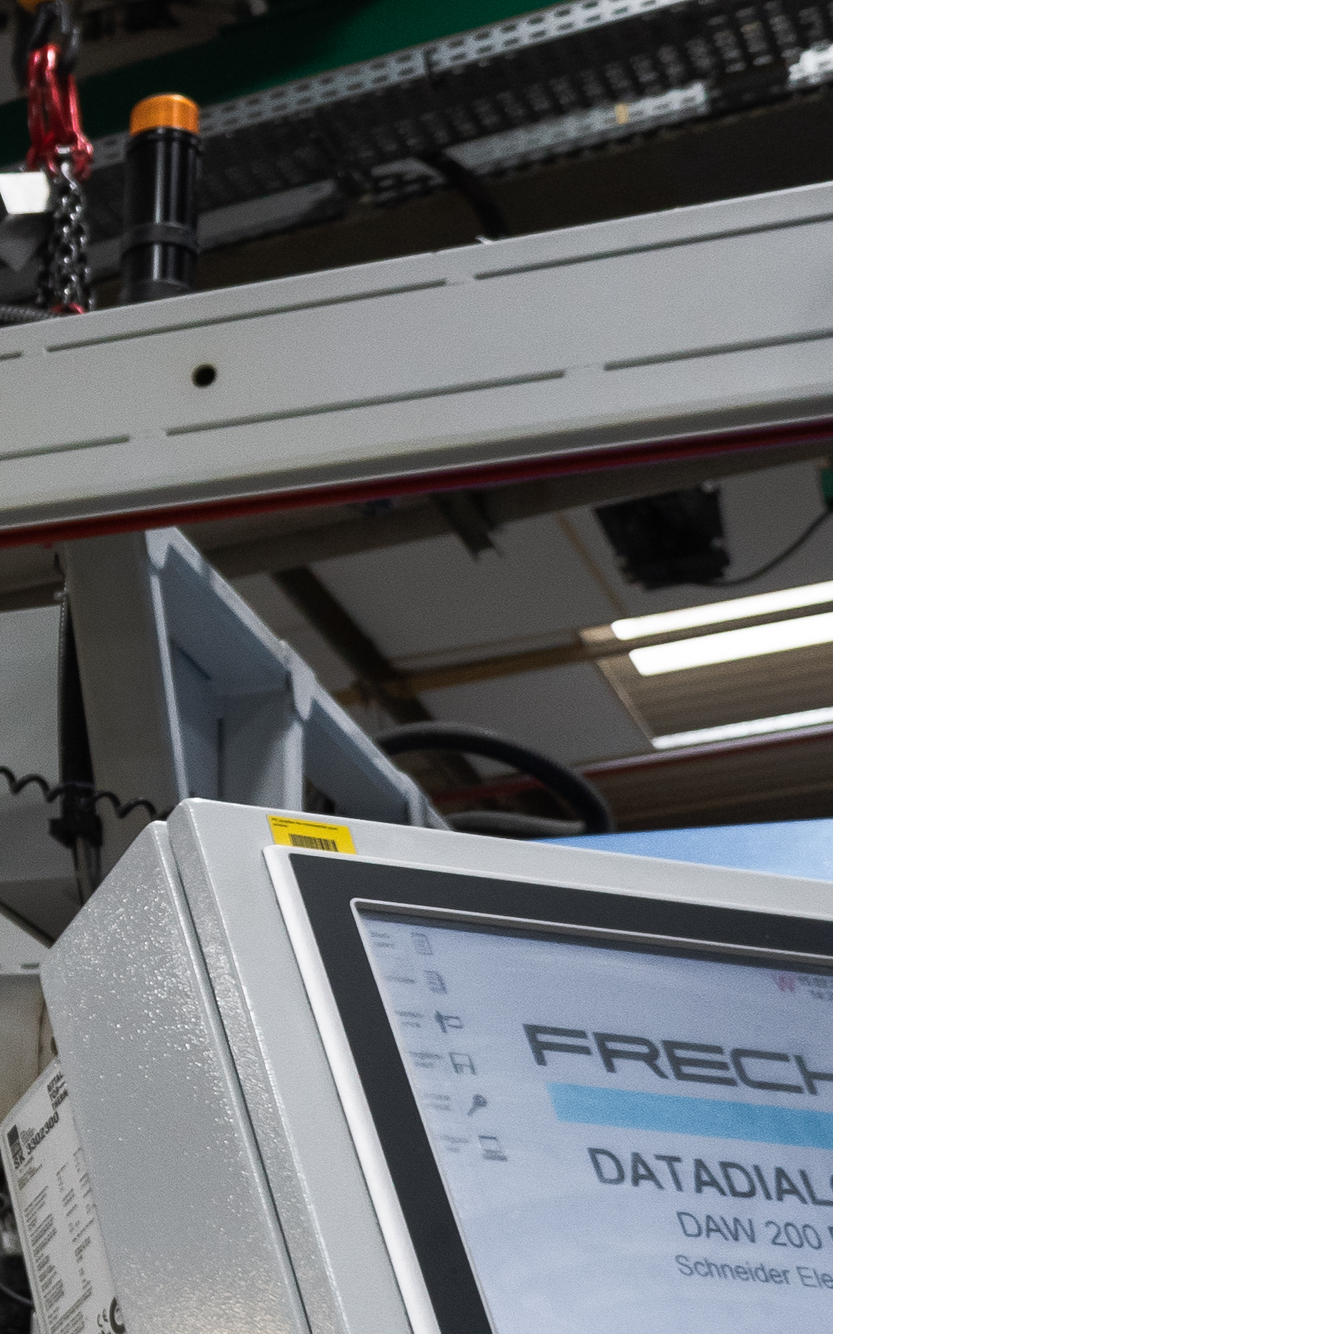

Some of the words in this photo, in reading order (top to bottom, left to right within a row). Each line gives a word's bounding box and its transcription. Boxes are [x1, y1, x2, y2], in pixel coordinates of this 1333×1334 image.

[587, 1147, 833, 1207] DATADIAL
[676, 1211, 756, 1244] DAW
[765, 1220, 823, 1250] 200
[675, 1254, 791, 1286] Schneider
